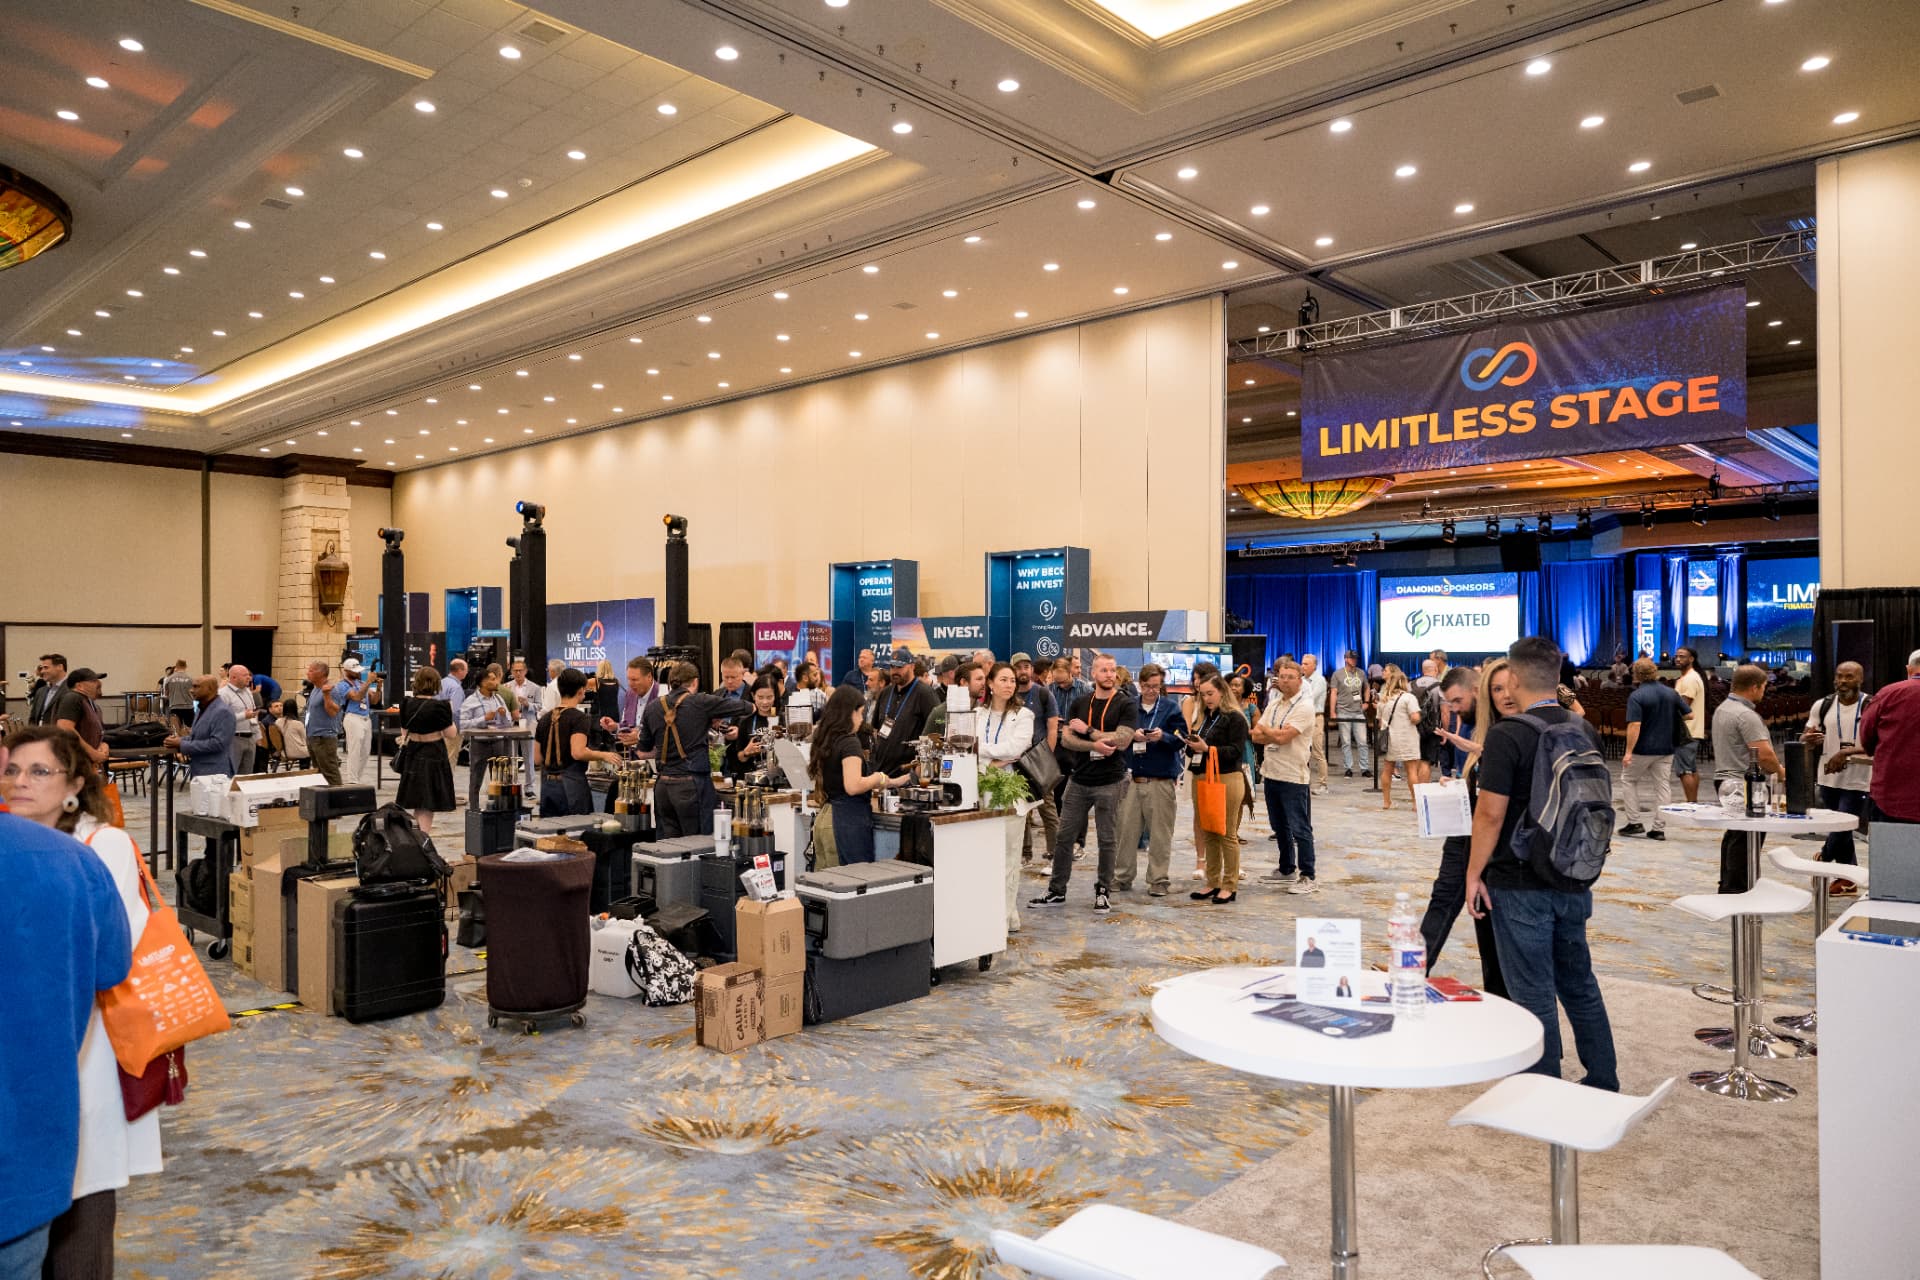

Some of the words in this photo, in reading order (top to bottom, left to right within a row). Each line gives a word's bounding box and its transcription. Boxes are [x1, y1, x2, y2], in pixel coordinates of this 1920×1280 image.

[1320, 400, 1537, 456] LIMITLESS
[1550, 375, 1720, 430] STAGE
[1017, 568, 1040, 577] WHY
[1016, 581, 1030, 590] AN
[1396, 585, 1441, 594] DIAMOND
[1442, 583, 1495, 593] SPONSORS
[1433, 613, 1490, 627] FIXATED
[758, 630, 794, 641] LEARN.
[933, 626, 983, 639] INVEST.
[1069, 623, 1153, 638] ADVANCE.
[567, 633, 581, 642] LIVE
[564, 647, 606, 660] LIMITLESS
[736, 994, 745, 1040] CALIFIA
